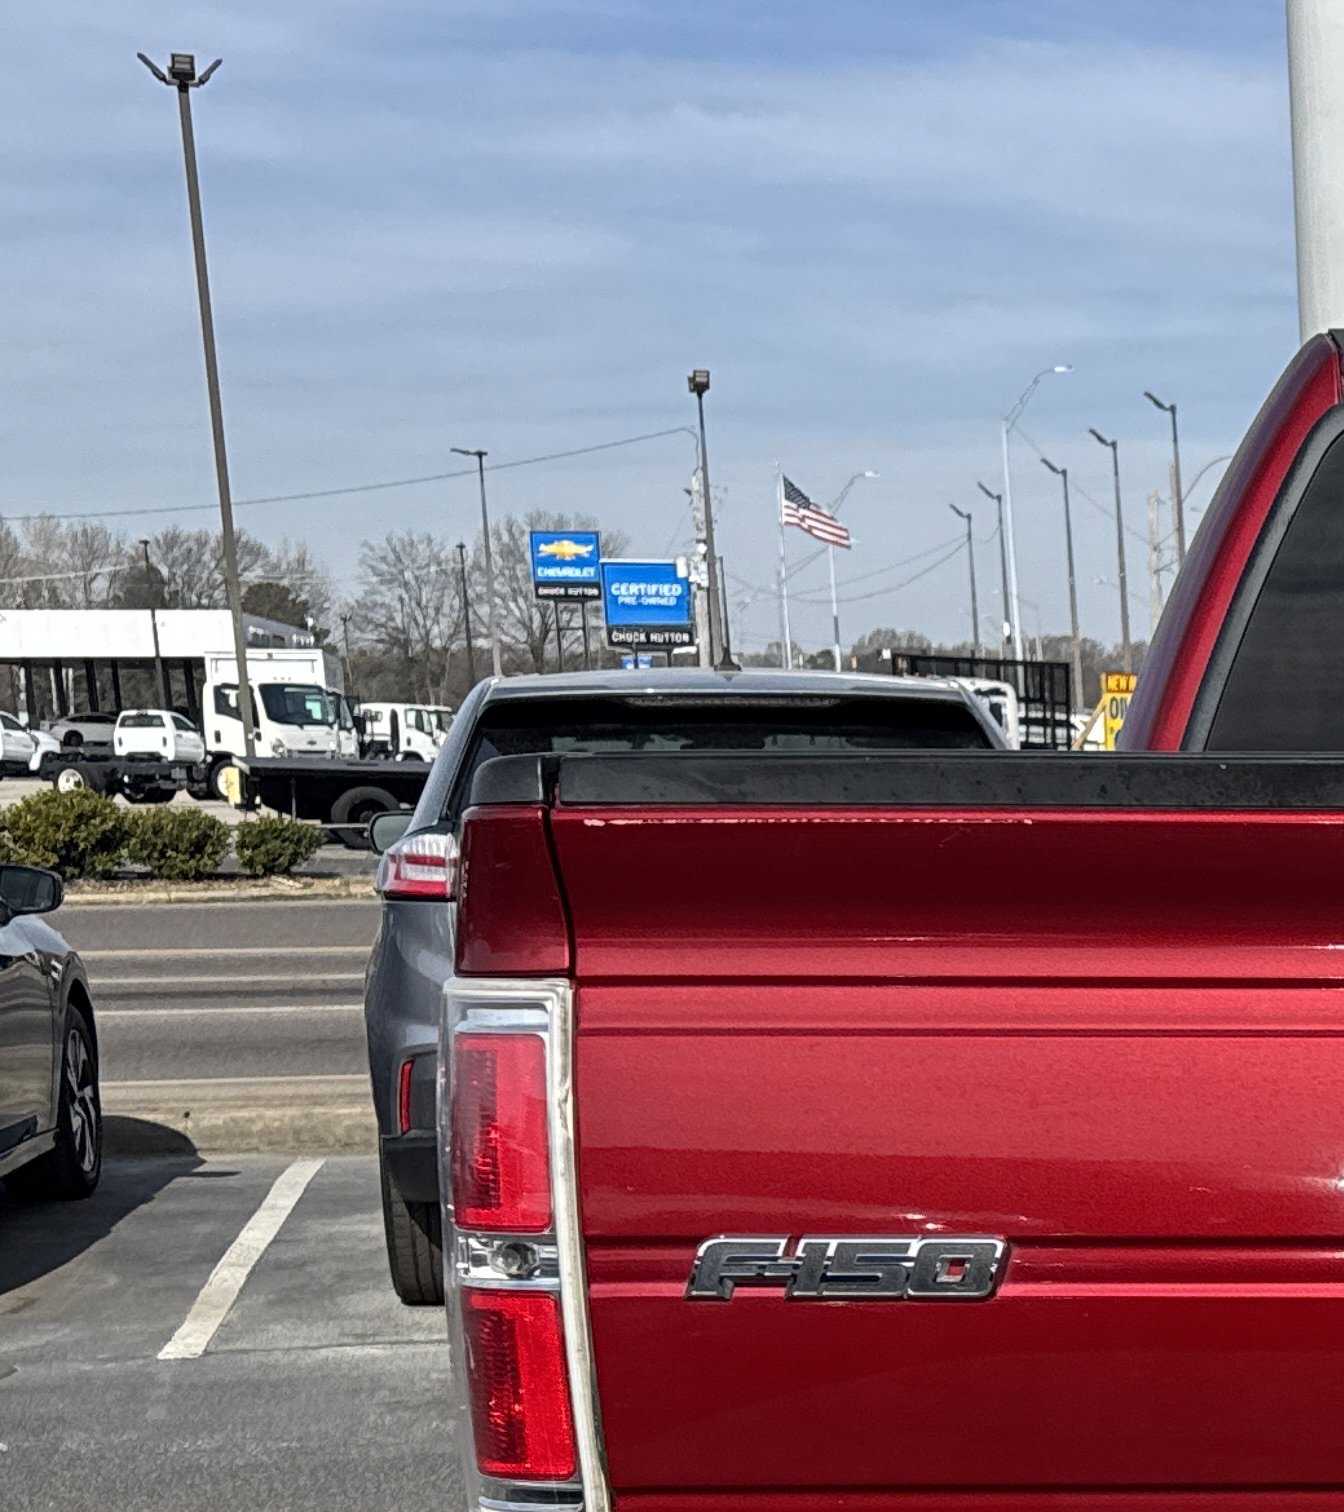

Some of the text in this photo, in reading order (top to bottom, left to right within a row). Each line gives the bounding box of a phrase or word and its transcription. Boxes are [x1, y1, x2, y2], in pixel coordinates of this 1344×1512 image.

[537, 566, 595, 577] CHEVROLET
[611, 582, 682, 597] CERTIFIED
[617, 596, 677, 606] PRE-OWNED
[611, 630, 690, 643] CHUCK HUTTON
[685, 1235, 1008, 1299] F-150
